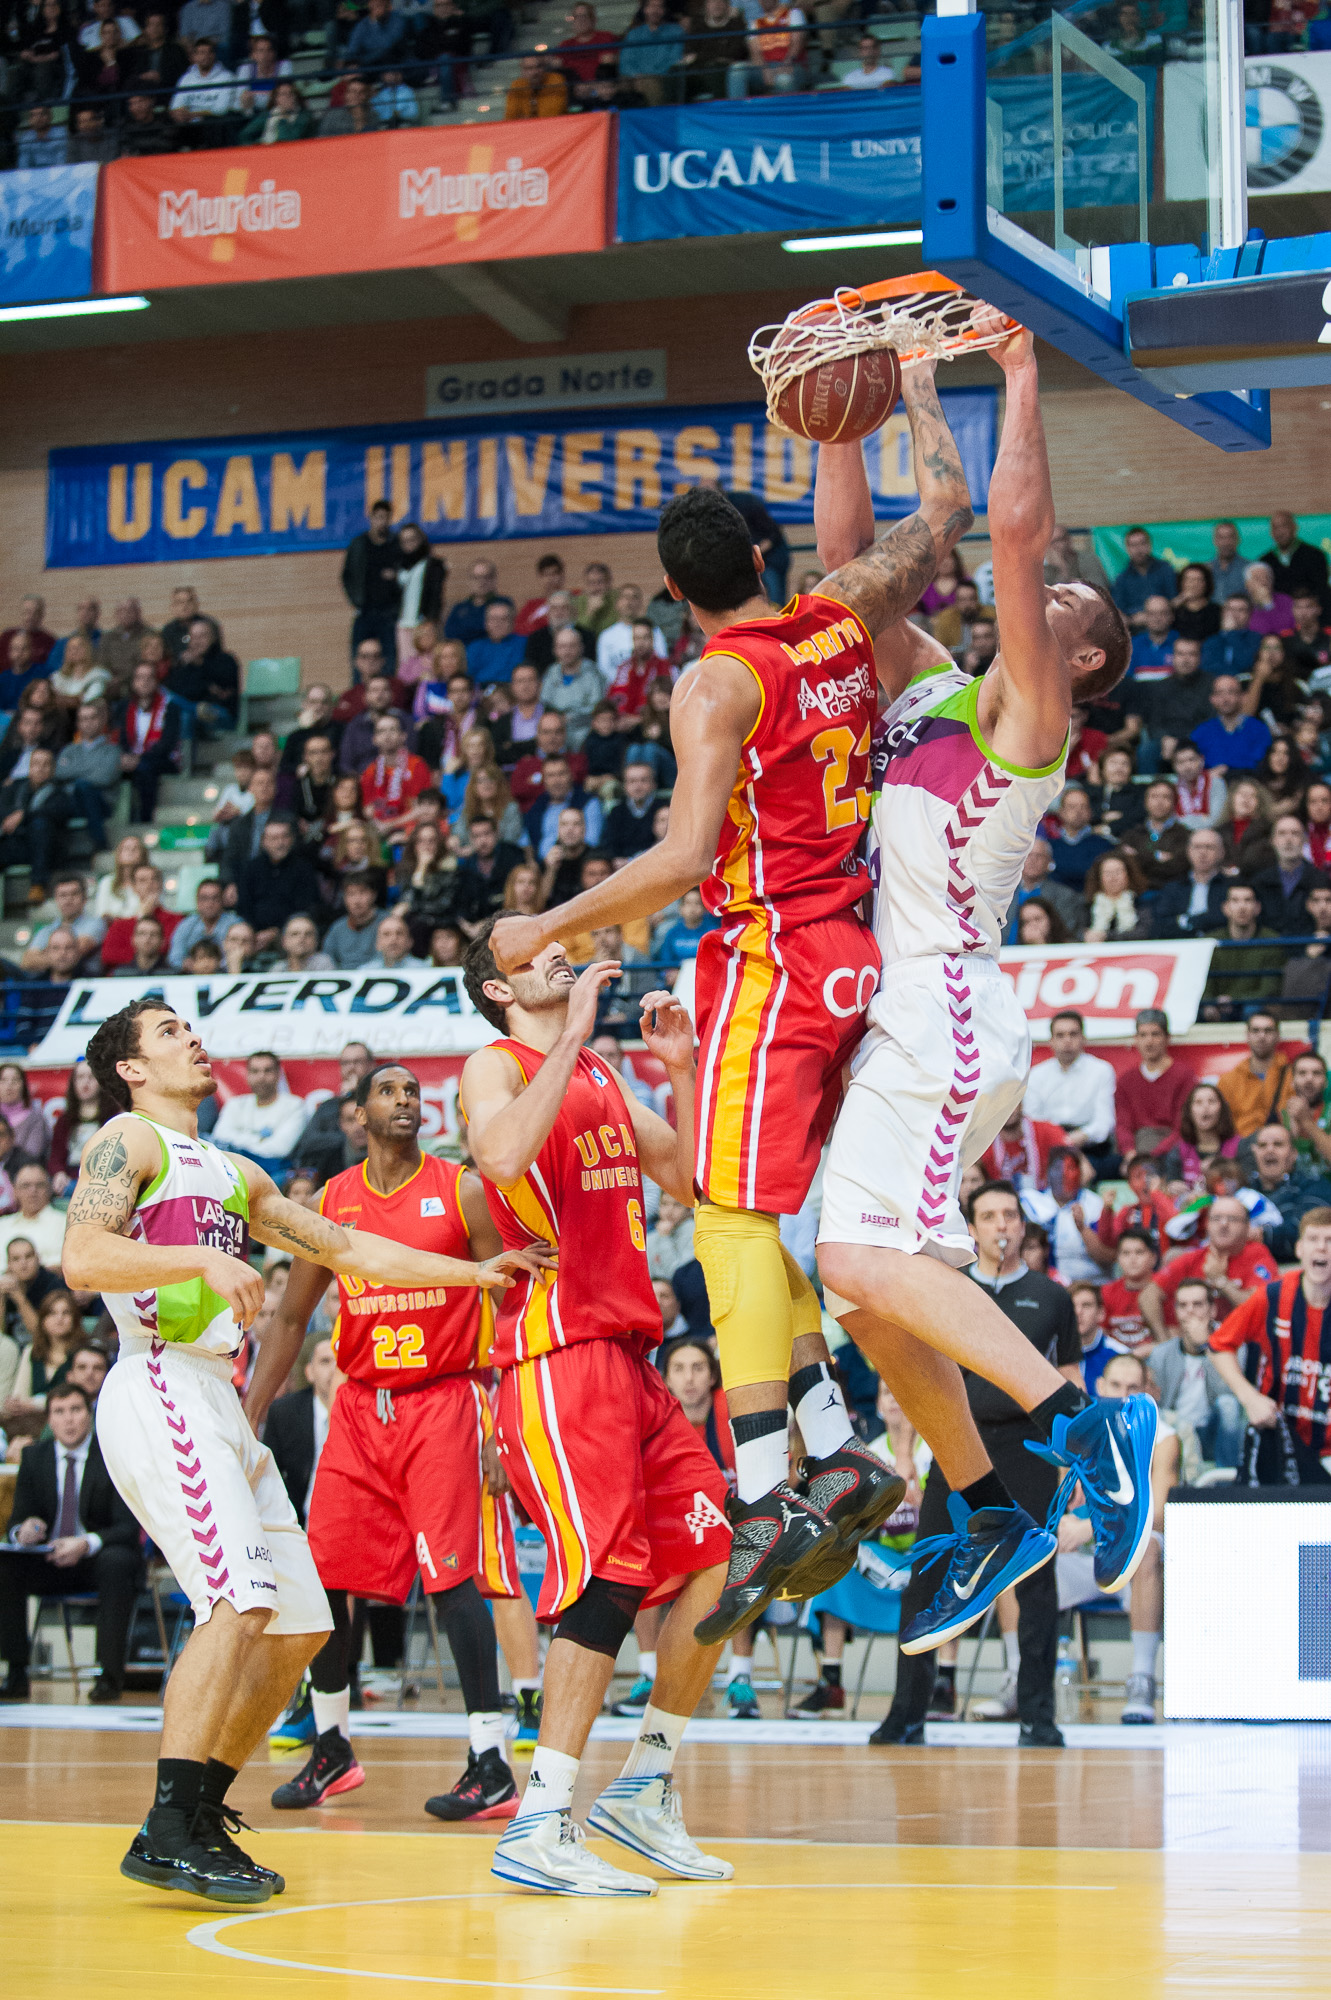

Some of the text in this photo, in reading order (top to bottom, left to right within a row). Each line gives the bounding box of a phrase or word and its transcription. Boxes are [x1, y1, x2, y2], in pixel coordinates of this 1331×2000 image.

[399, 157, 549, 218] Murcia
[633, 143, 799, 193] UCAM
[159, 179, 301, 239] Murcia
[438, 363, 654, 403] Grada Norte
[108, 413, 918, 542] UCAM UNIVERSIDD
[829, 696, 851, 717] de
[196, 977, 484, 1018] VERDA
[627, 1198, 646, 1252] 6
[861, 1213, 899, 1228] BASKONIA
[347, 1288, 447, 1316] UNIVERSIDAD
[371, 1323, 428, 1370] 22
[606, 1554, 642, 1571] SPALDING
[639, 1734, 672, 1751] adidas
